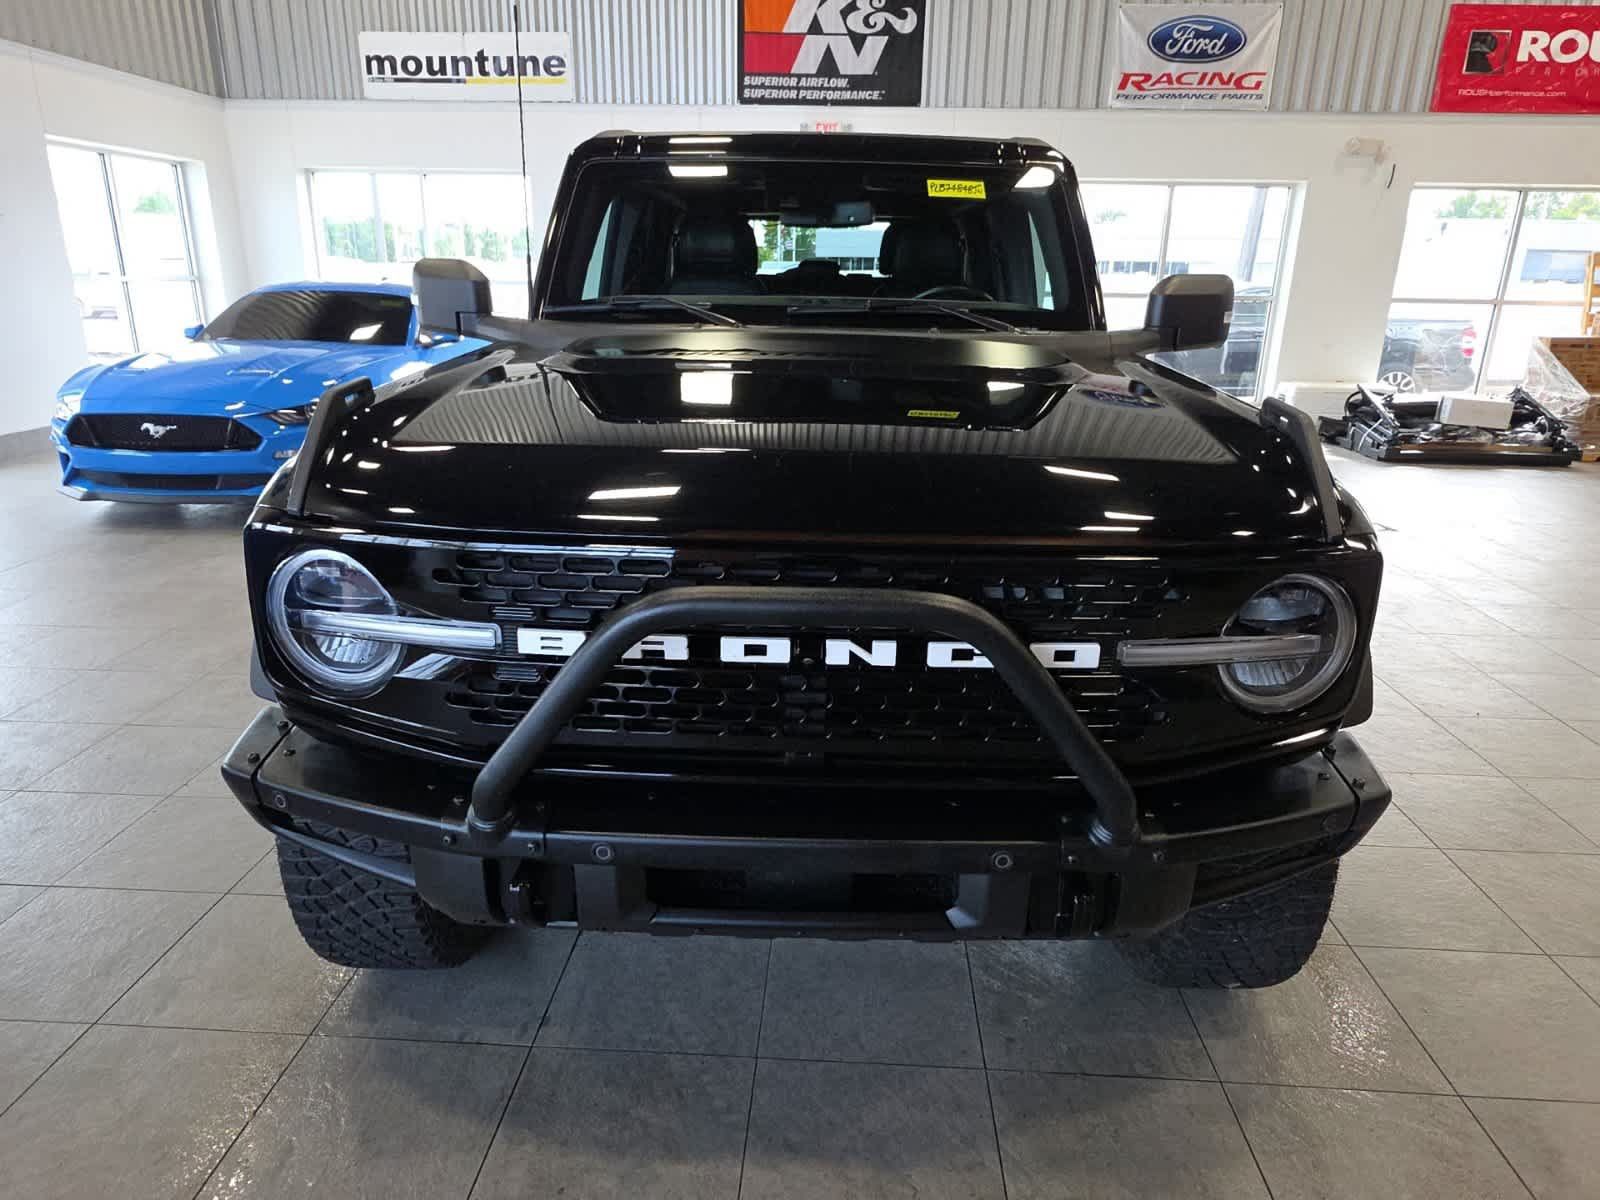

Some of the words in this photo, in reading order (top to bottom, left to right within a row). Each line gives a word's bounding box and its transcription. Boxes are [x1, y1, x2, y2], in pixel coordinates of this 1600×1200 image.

[1165, 23, 1229, 55] Ford
[365, 48, 567, 77] mountune
[743, 76, 798, 87] SUPERIOR
[799, 78, 850, 88] AIRFLOW.
[1117, 71, 1268, 92] RACING
[743, 88, 798, 99] SUPERIOR
[1116, 93, 1218, 101] PERFORMANCE
[516, 627, 1101, 669] BRONCO
